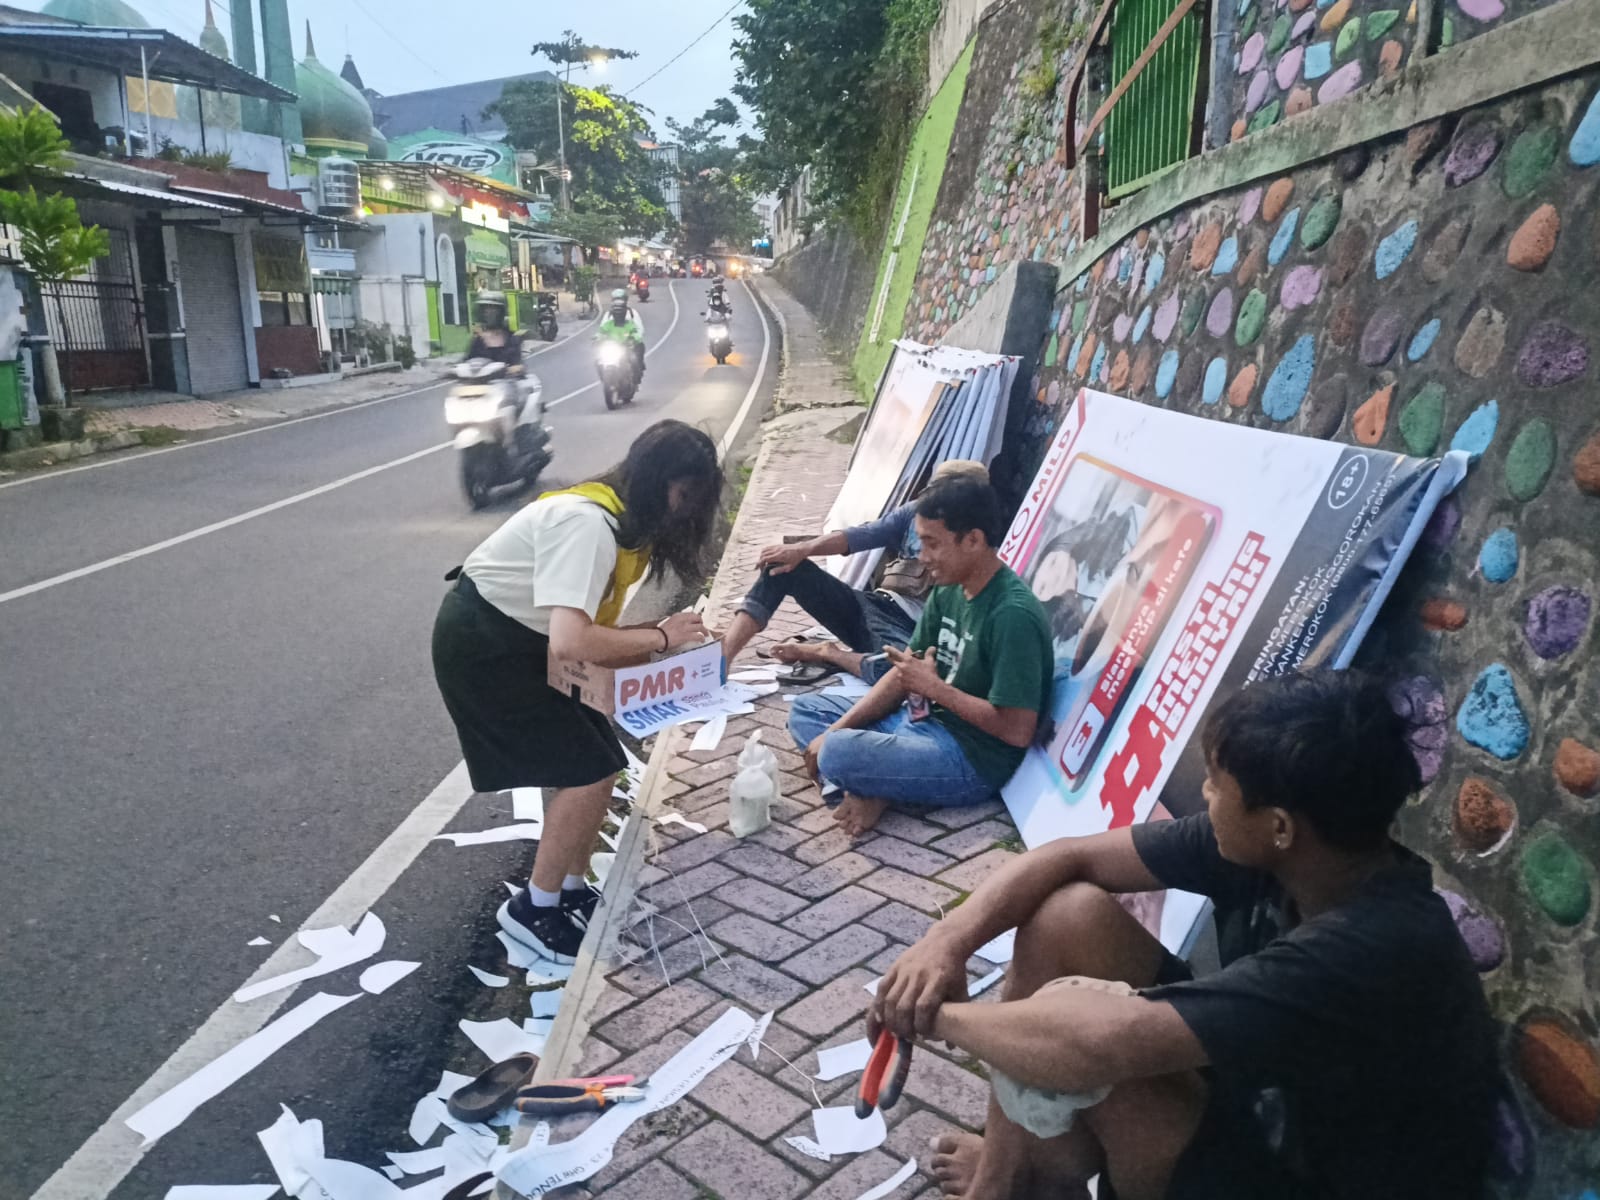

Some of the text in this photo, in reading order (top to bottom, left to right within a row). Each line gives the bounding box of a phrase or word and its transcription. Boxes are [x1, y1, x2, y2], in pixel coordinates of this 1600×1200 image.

[999, 429, 1071, 562] RO MILD
[1307, 480, 1382, 610] TENGGOROKAN
[1334, 462, 1360, 500] 18+
[620, 665, 686, 707] PMR
[1145, 585, 1217, 713] PASTI
[1155, 537, 1260, 723] MENANG
[1164, 557, 1266, 733] BANYAK
[1292, 592, 1333, 670] MEROKOK
[621, 699, 691, 731] SMAK
